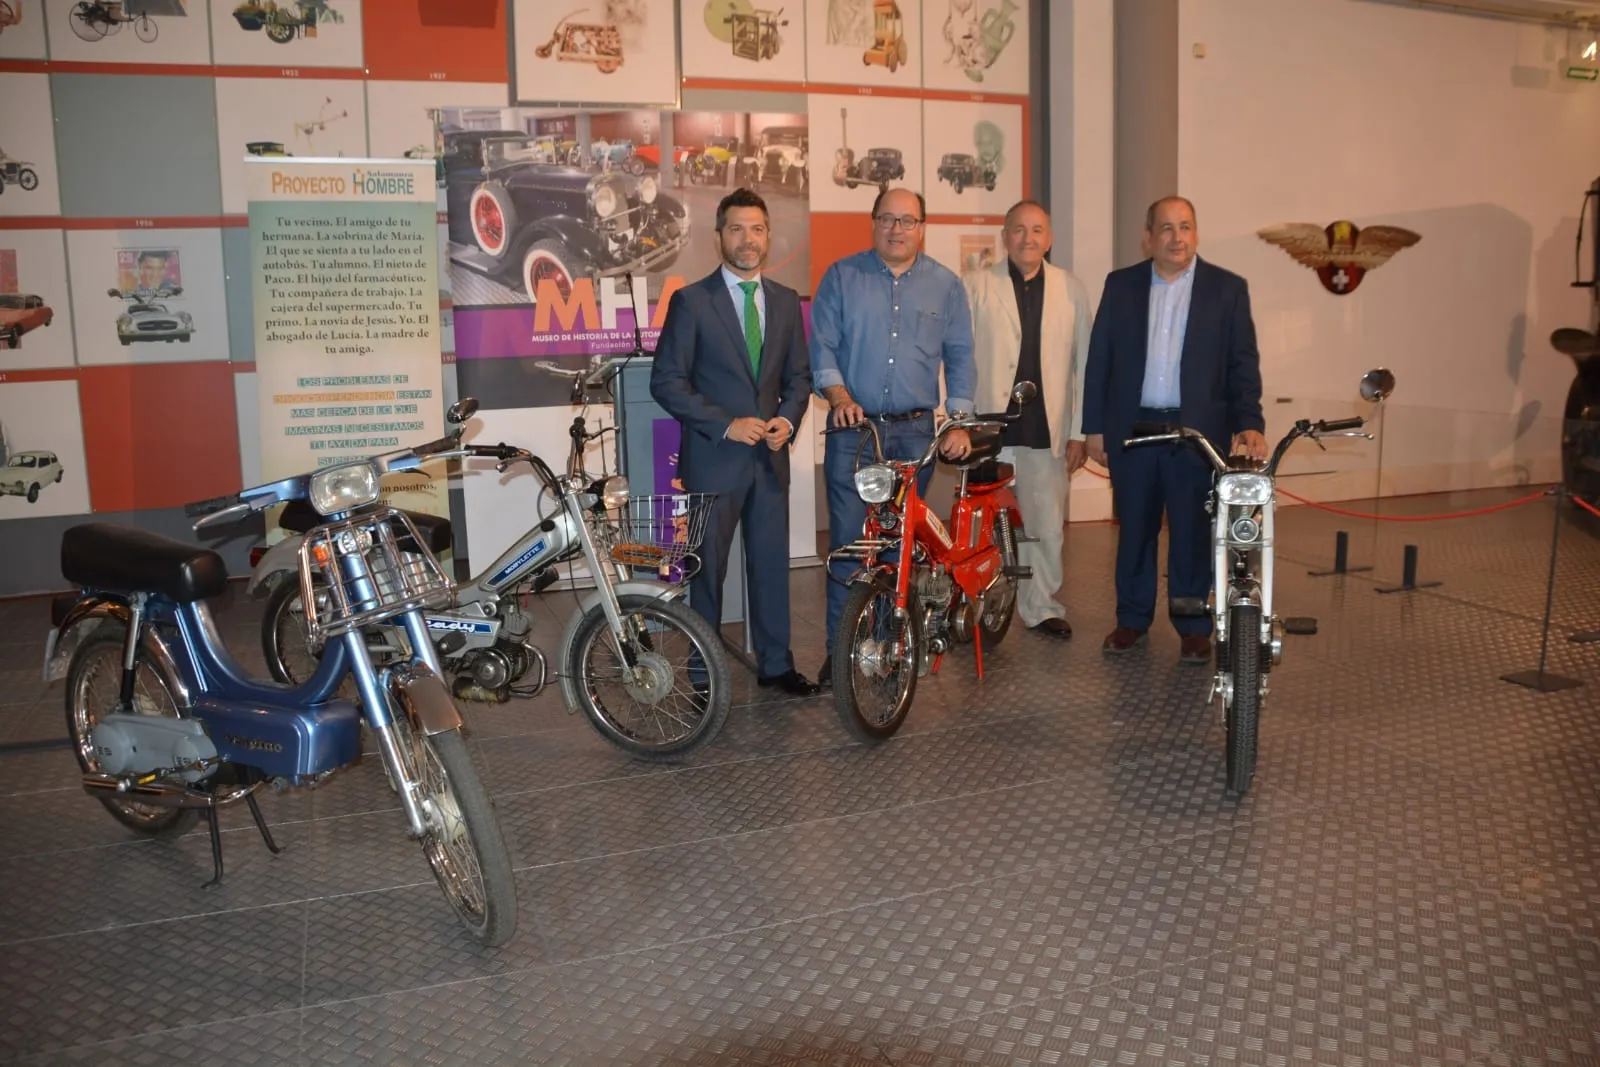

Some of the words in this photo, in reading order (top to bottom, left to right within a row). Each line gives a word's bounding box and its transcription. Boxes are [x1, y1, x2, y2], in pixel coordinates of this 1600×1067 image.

[271, 171, 345, 195] PROYECTO
[352, 169, 414, 195] HOMBRE
[276, 217, 291, 226] Tu
[294, 217, 333, 227] vecino.
[336, 217, 348, 226] El
[350, 217, 382, 230] amigo
[385, 216, 398, 226] de
[400, 217, 412, 226] tu
[262, 232, 314, 242] hermana.
[317, 231, 330, 240] La
[332, 231, 374, 241] sobrina
[376, 231, 388, 240] de
[266, 246, 278, 256] El
[280, 248, 300, 258] que
[316, 246, 348, 255] sienta
[359, 246, 370, 255] tu
[372, 245, 396, 255] lado
[413, 245, 423, 254] el
[262, 260, 308, 270] autobús.
[312, 260, 326, 269] Tu
[328, 260, 371, 269] alumno.
[374, 260, 384, 268] El
[386, 260, 412, 268] nieto
[414, 258, 427, 268] de
[264, 274, 294, 284] Paco.
[297, 274, 308, 284] El
[310, 274, 332, 286] hijo
[335, 273, 352, 282] del
[354, 272, 426, 283] farmacéutico.
[270, 288, 286, 298] Tu
[288, 288, 348, 300] compañera
[351, 287, 363, 297] de
[366, 287, 408, 300] trabajo.
[410, 287, 422, 296] La
[271, 303, 304, 314] cajera
[306, 302, 323, 312] del
[326, 302, 404, 313] supermercado.
[408, 302, 422, 310] Tu
[265, 317, 302, 329] primo.
[304, 317, 318, 326] La
[320, 316, 348, 326] novia
[351, 316, 364, 325] de
[400, 316, 416, 324] Yo.
[418, 315, 428, 324] El
[266, 332, 313, 342] abogado
[315, 331, 328, 340] de
[366, 330, 379, 339] La
[382, 329, 414, 339] madre
[417, 328, 430, 338] de
[532, 334, 559, 342] MUSEO
[562, 334, 572, 342] DE
[573, 332, 608, 340] HISTORIA
[610, 332, 620, 340] DE
[325, 346, 336, 354] tu
[339, 345, 374, 356] amiga.
[591, 341, 630, 350] Fundación
[298, 377, 321, 387] LOS
[393, 375, 408, 384] DE
[317, 406, 358, 416] CERCA
[344, 421, 424, 434] NECESITAMOS
[311, 440, 326, 450] TU
[504, 544, 541, 574] MOBYLETTE
